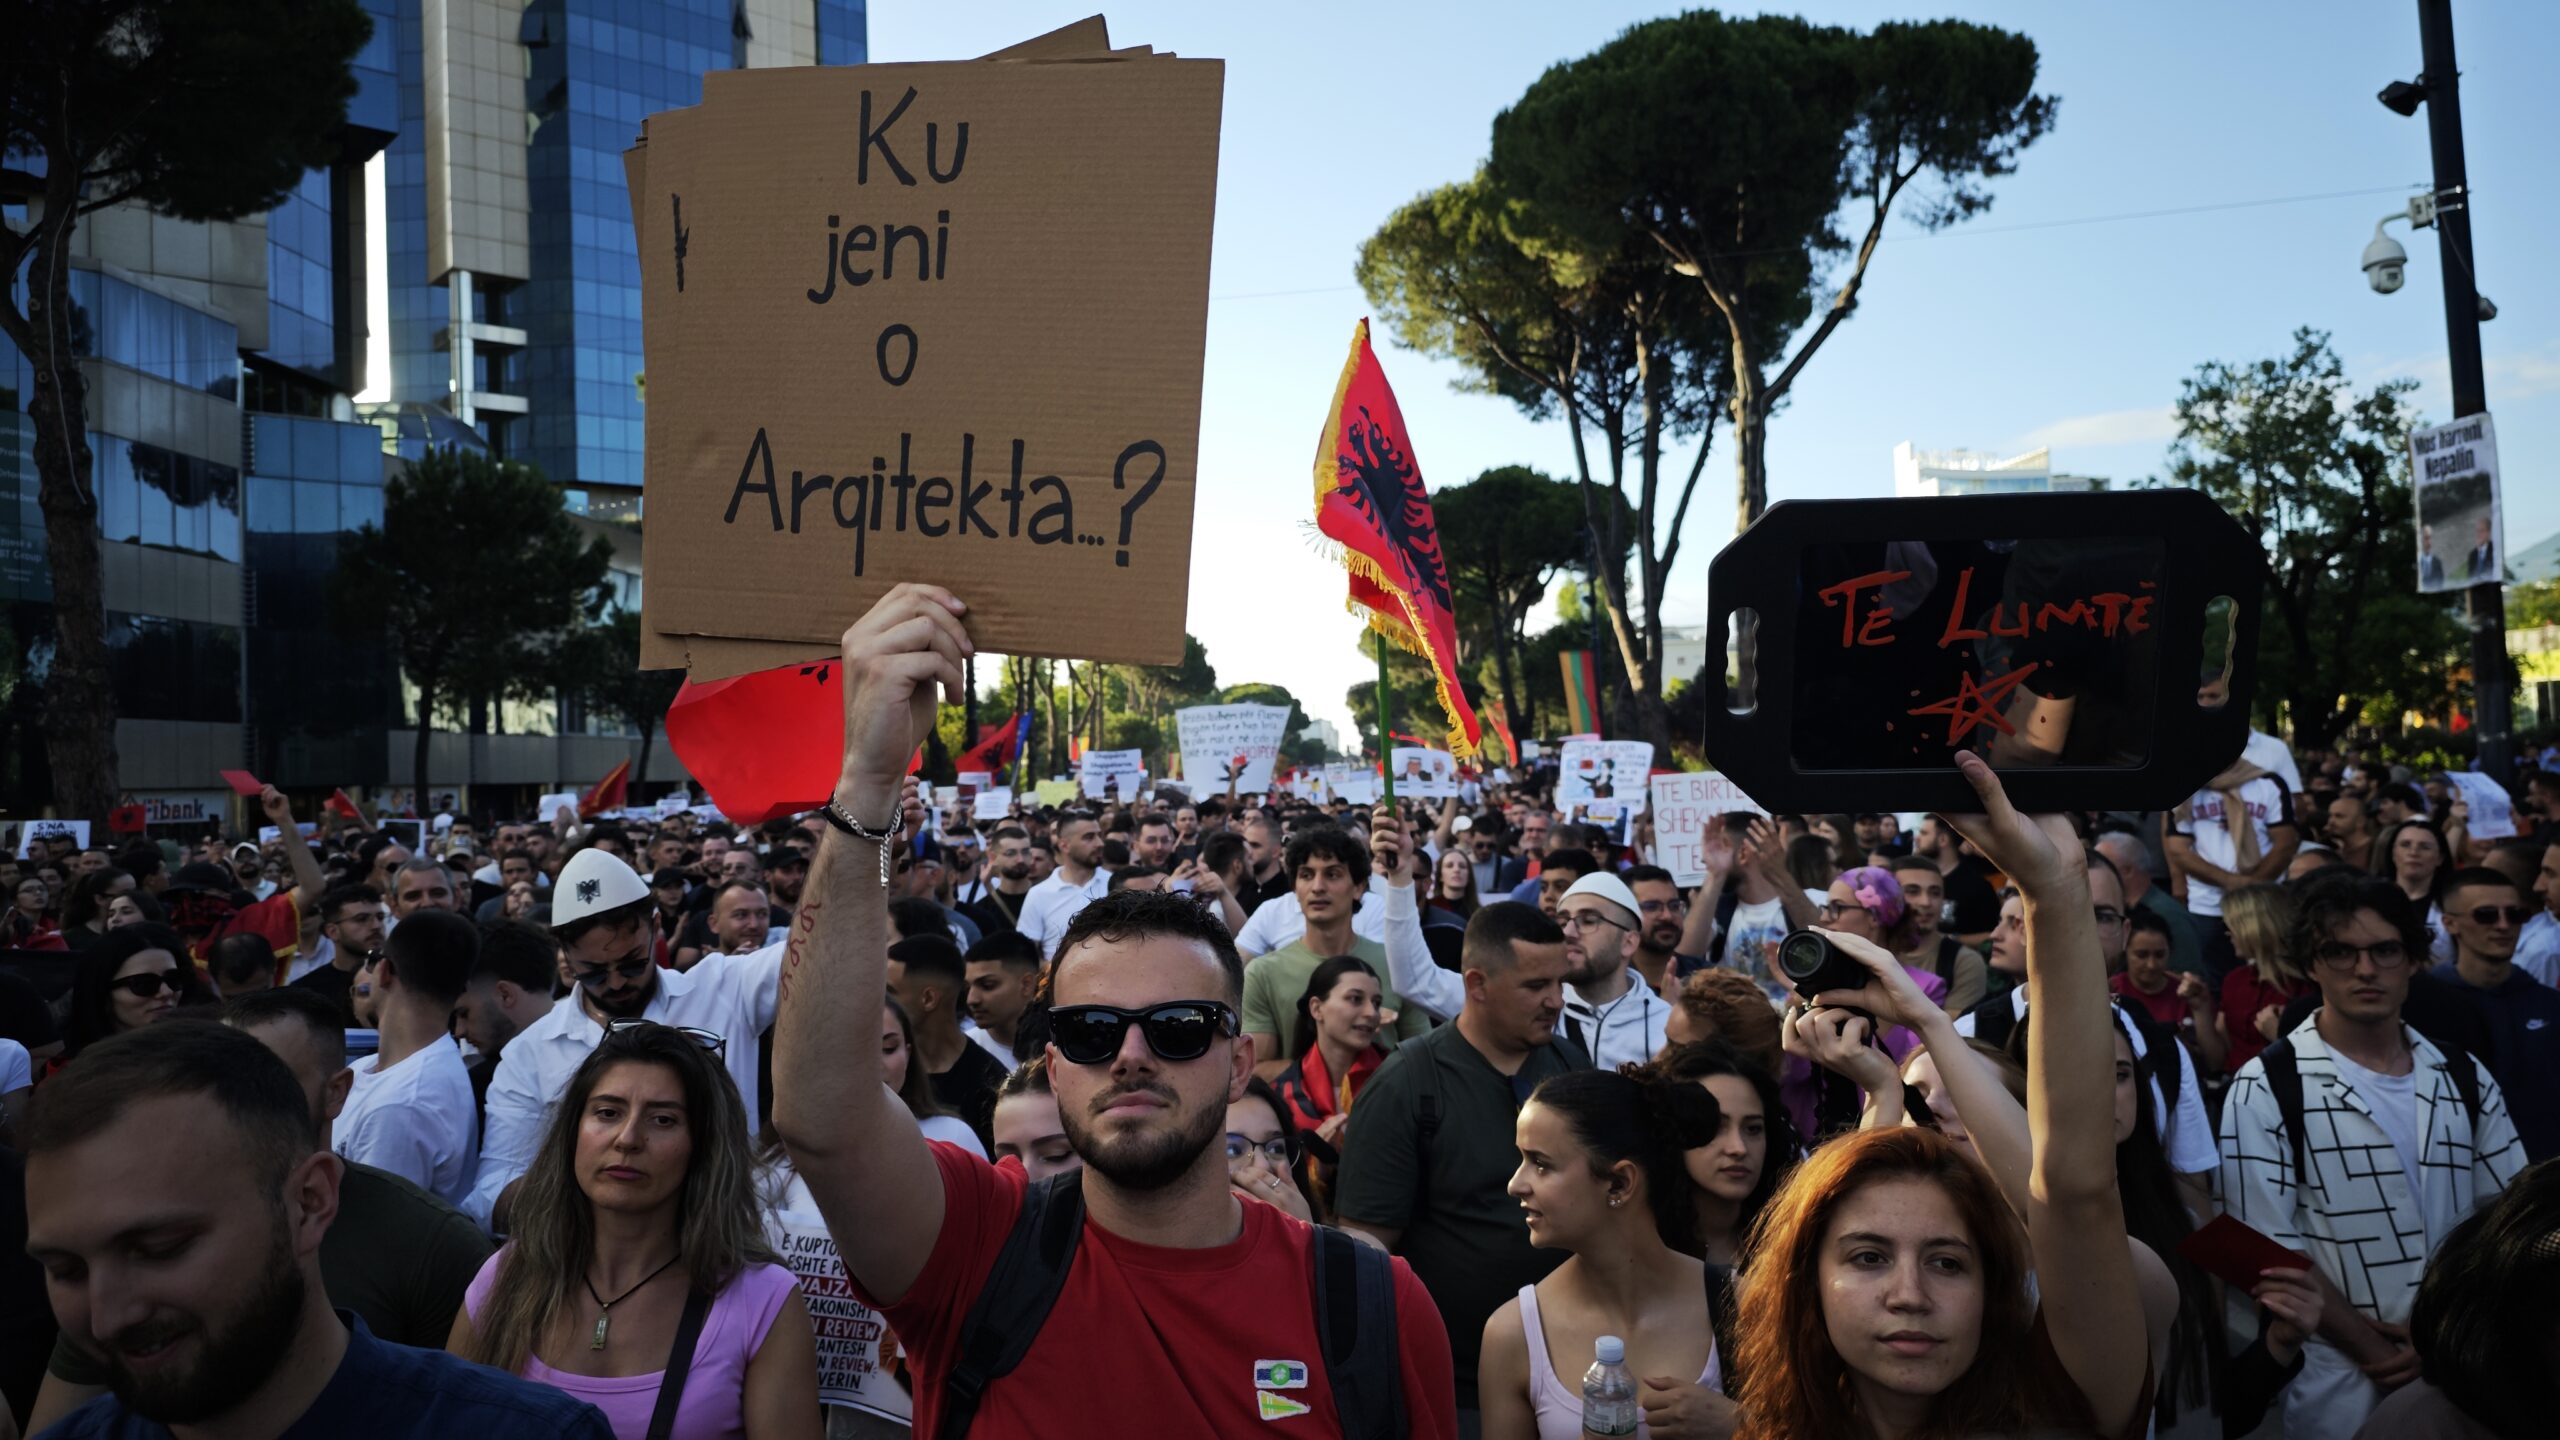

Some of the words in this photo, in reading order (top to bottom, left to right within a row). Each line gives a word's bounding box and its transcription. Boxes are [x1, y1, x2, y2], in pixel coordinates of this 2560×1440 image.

[857, 86, 969, 187] Ku
[806, 210, 950, 304] jeni
[2414, 435, 2436, 456] Mos
[795, 1235, 840, 1257] KUPTO
[824, 1319, 878, 1340] REVIEW
[815, 1338, 867, 1357] ANTESH
[830, 1356, 875, 1374] REVIEW
[817, 1371, 861, 1390] VERIN
